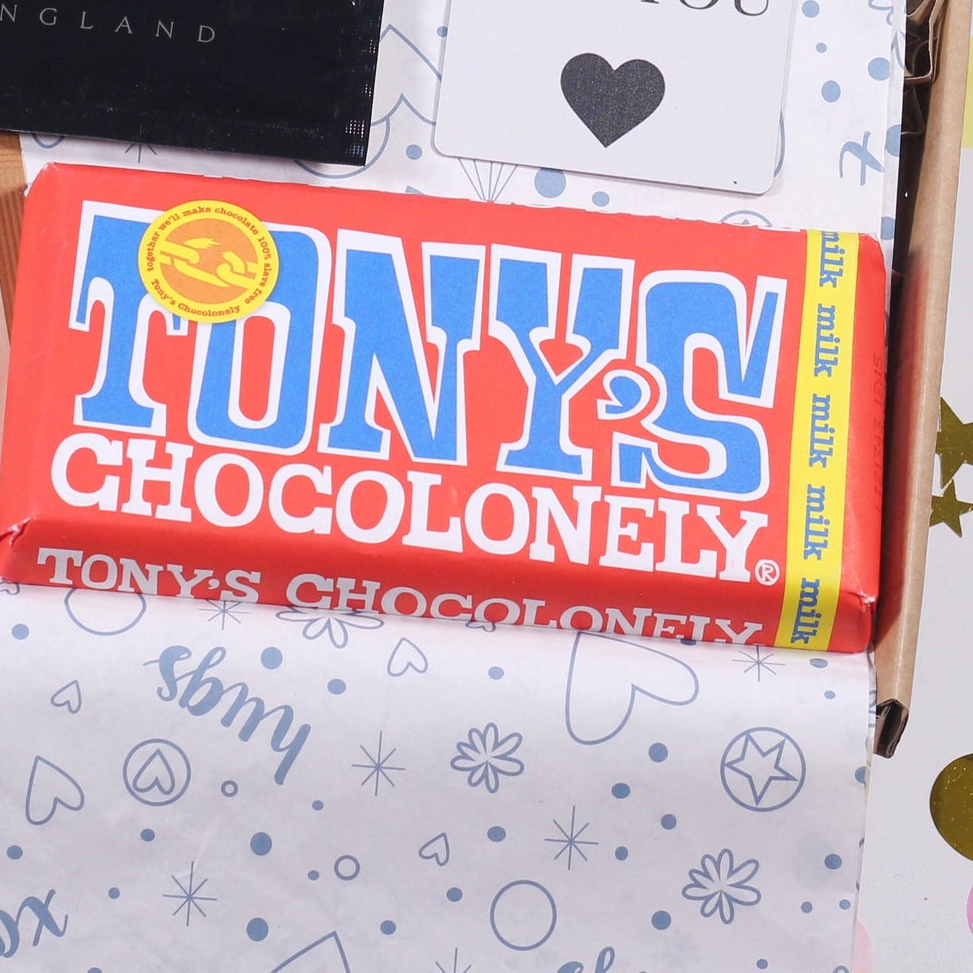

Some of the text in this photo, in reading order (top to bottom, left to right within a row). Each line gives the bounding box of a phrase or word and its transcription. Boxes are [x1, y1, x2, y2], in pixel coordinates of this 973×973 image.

[146, 206, 272, 304] together we'll make chocolate 100% slave free
[151, 278, 241, 317] Tony's Chocolonely
[70, 201, 787, 501] TONY'S
[814, 303, 840, 377] milk
[808, 393, 835, 468] milk
[803, 486, 830, 560] milk
[37, 548, 261, 604] TONY'S
[790, 578, 823, 644] milk
[142, 645, 311, 786] hugs
